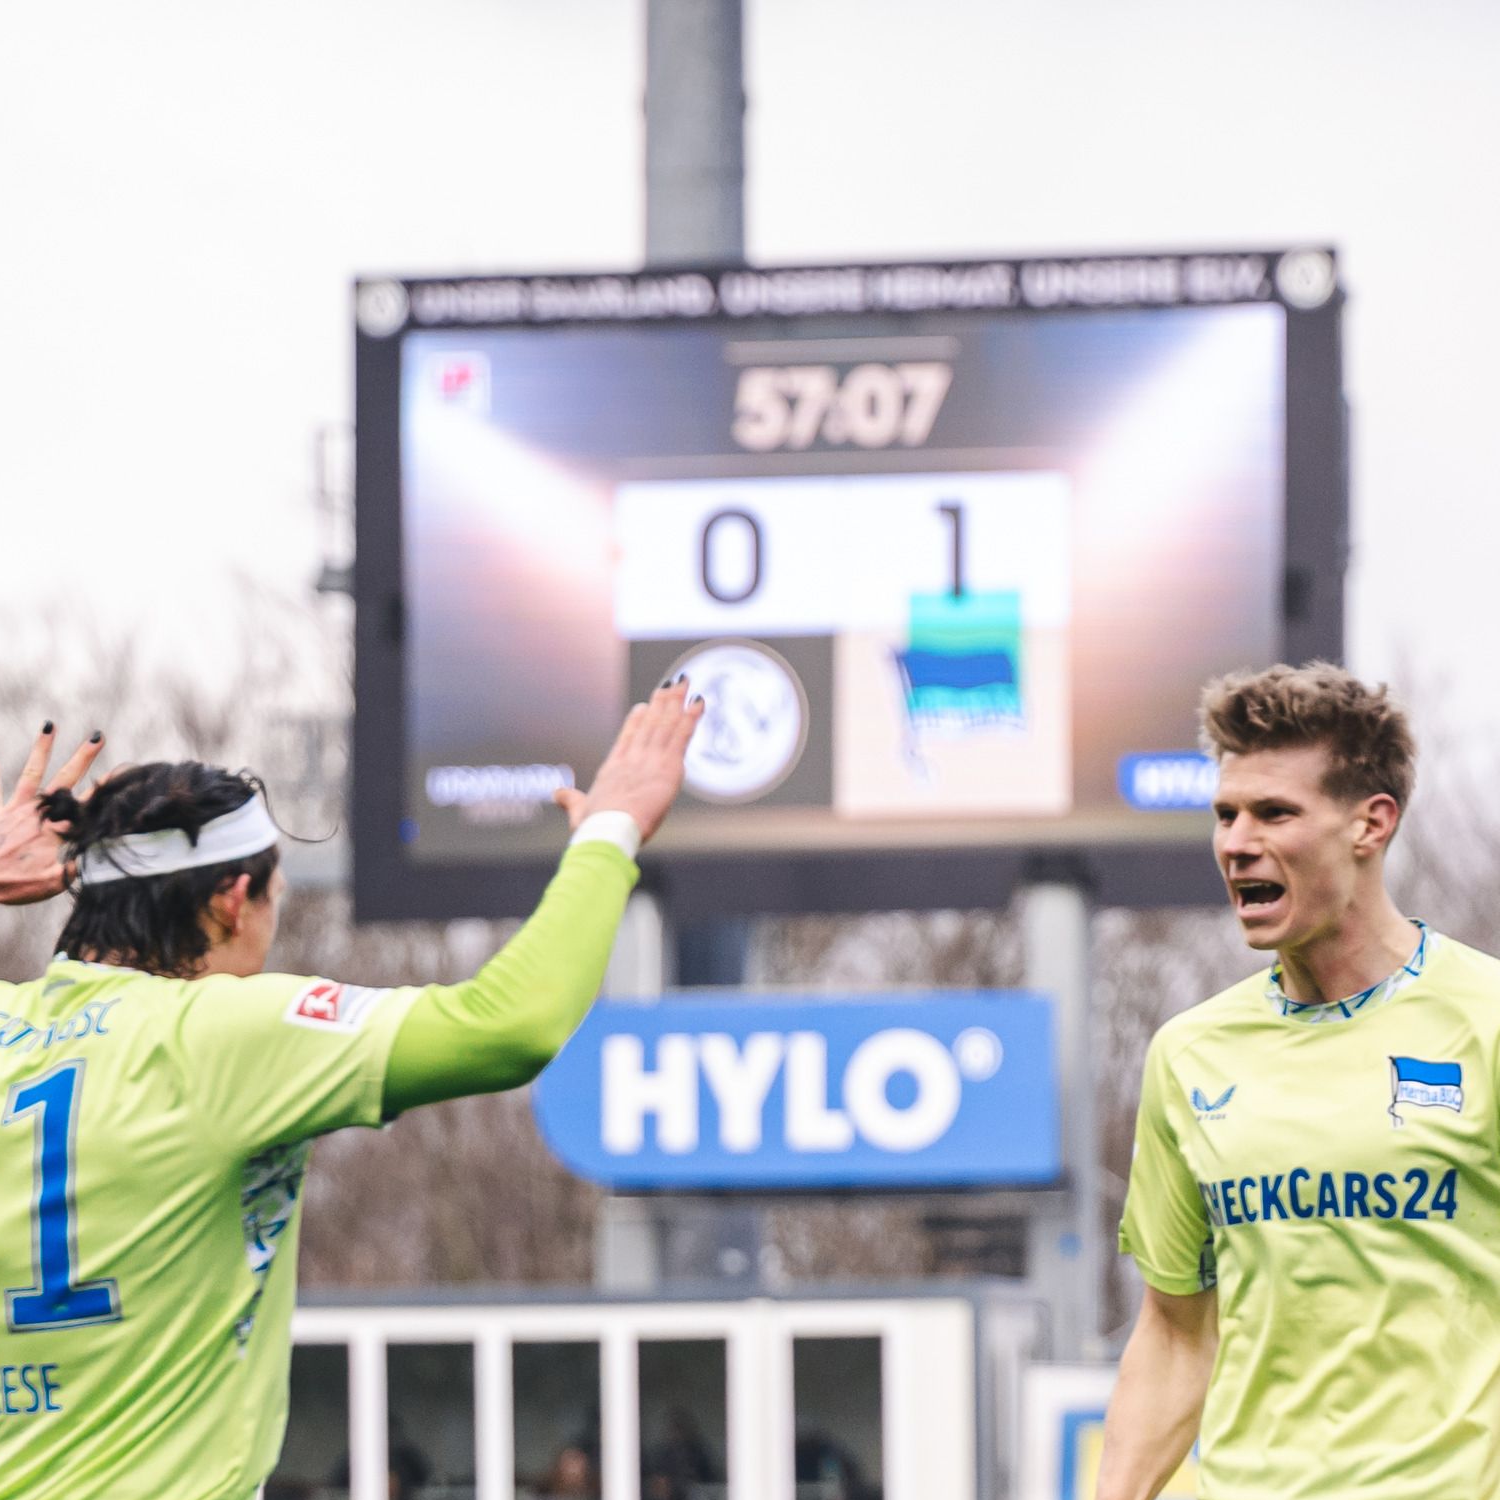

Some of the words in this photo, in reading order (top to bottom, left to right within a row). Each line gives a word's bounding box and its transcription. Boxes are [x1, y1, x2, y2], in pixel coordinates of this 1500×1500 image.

[731, 361, 953, 450] 57:07
[702, 508, 762, 604] 0
[935, 502, 963, 600] 1
[602, 1026, 962, 1155] HYLO
